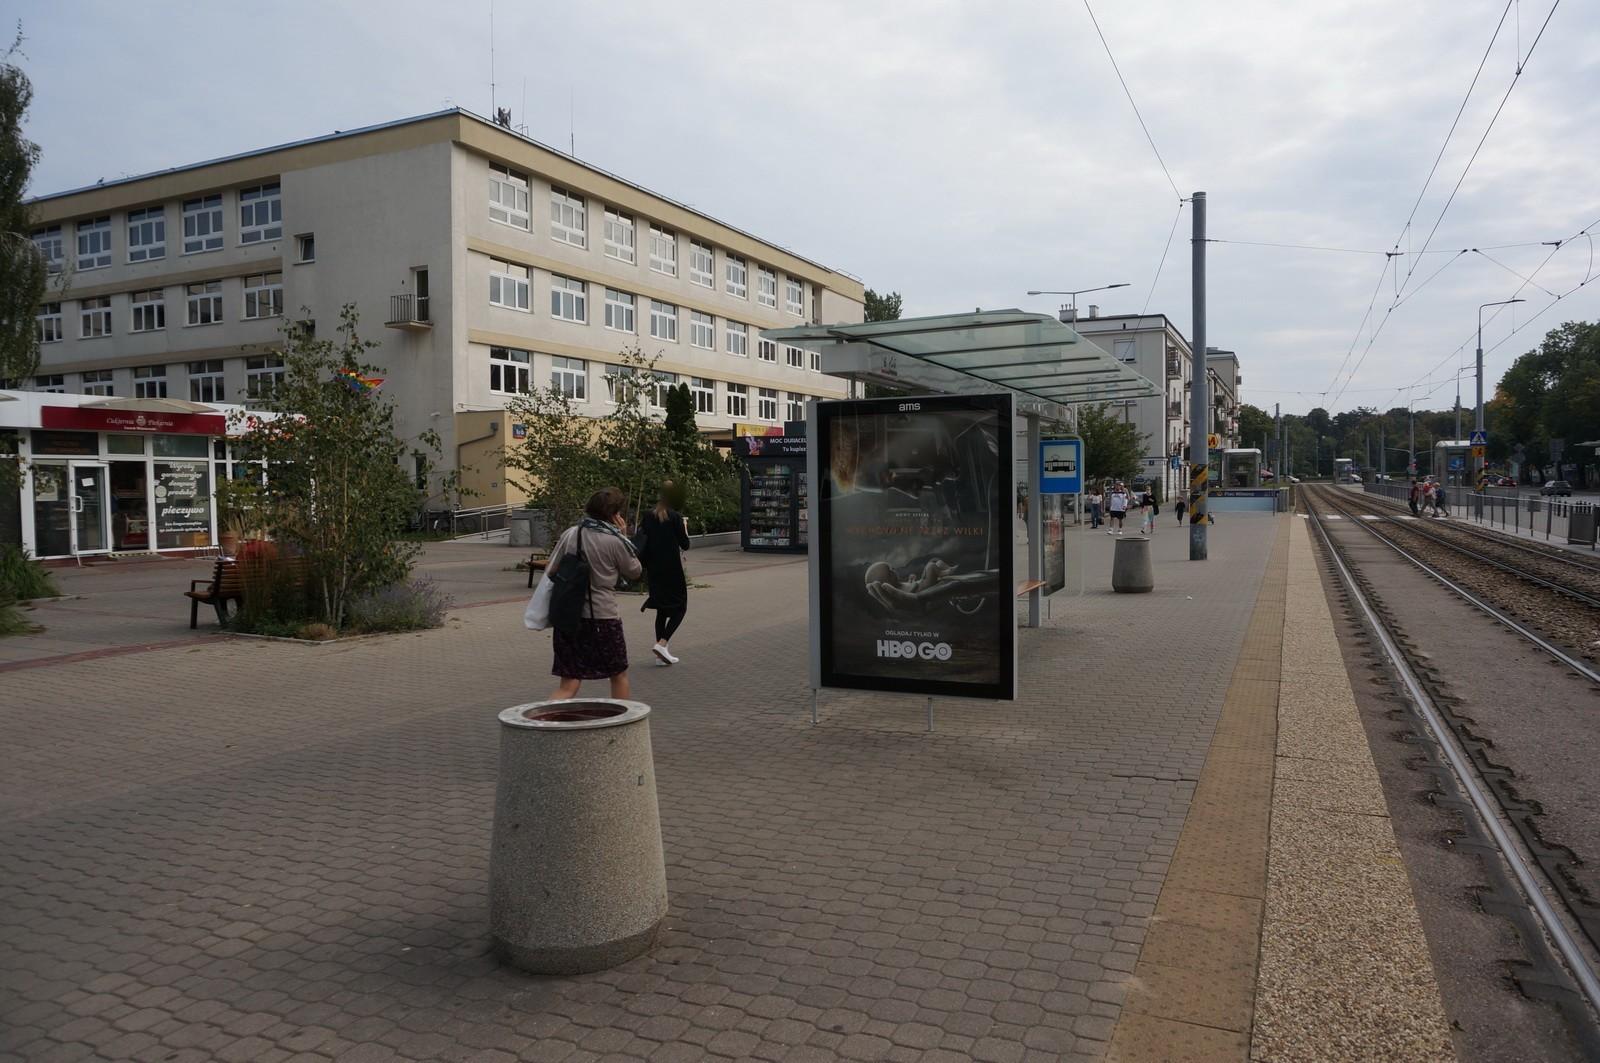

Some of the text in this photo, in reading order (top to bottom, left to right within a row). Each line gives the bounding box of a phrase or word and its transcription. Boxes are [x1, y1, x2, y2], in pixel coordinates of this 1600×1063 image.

[898, 402, 921, 412] ams
[161, 505, 205, 518] pieczywo
[953, 527, 983, 536] WILKI
[877, 640, 952, 660] HBO GO
